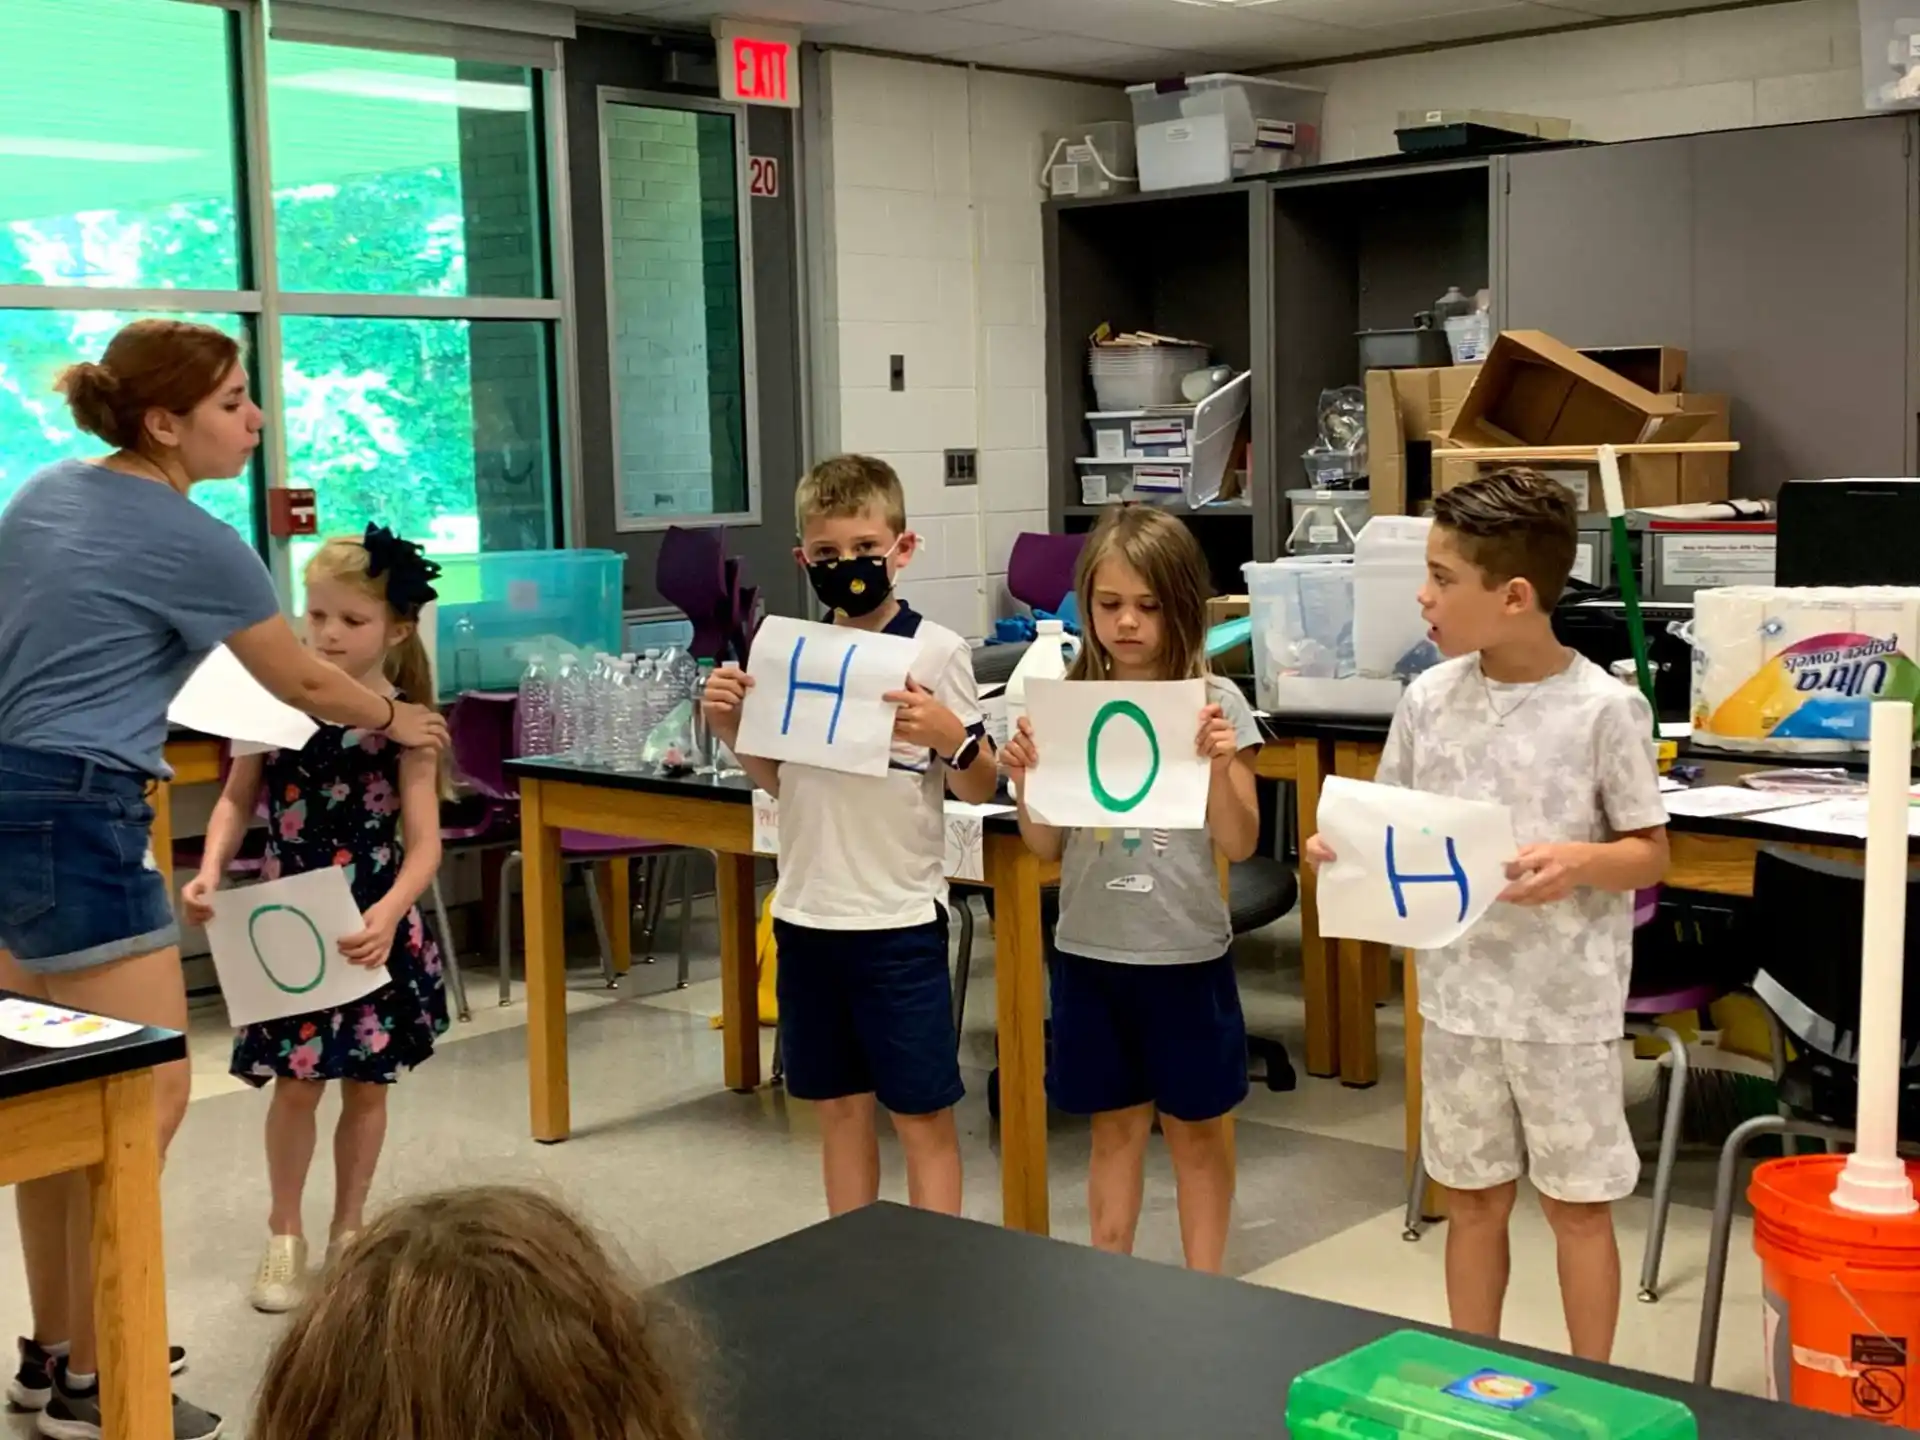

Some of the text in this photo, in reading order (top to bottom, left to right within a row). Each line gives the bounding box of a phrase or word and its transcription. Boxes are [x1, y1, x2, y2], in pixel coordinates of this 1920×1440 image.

[733, 37, 790, 101] EXIT
[750, 158, 776, 196] 20
[781, 637, 856, 744] H
[1783, 632, 1899, 674] paper towels
[1795, 659, 1888, 697] Ultra
[1087, 699, 1160, 813] O
[1385, 825, 1469, 922] H
[248, 903, 326, 994] O
